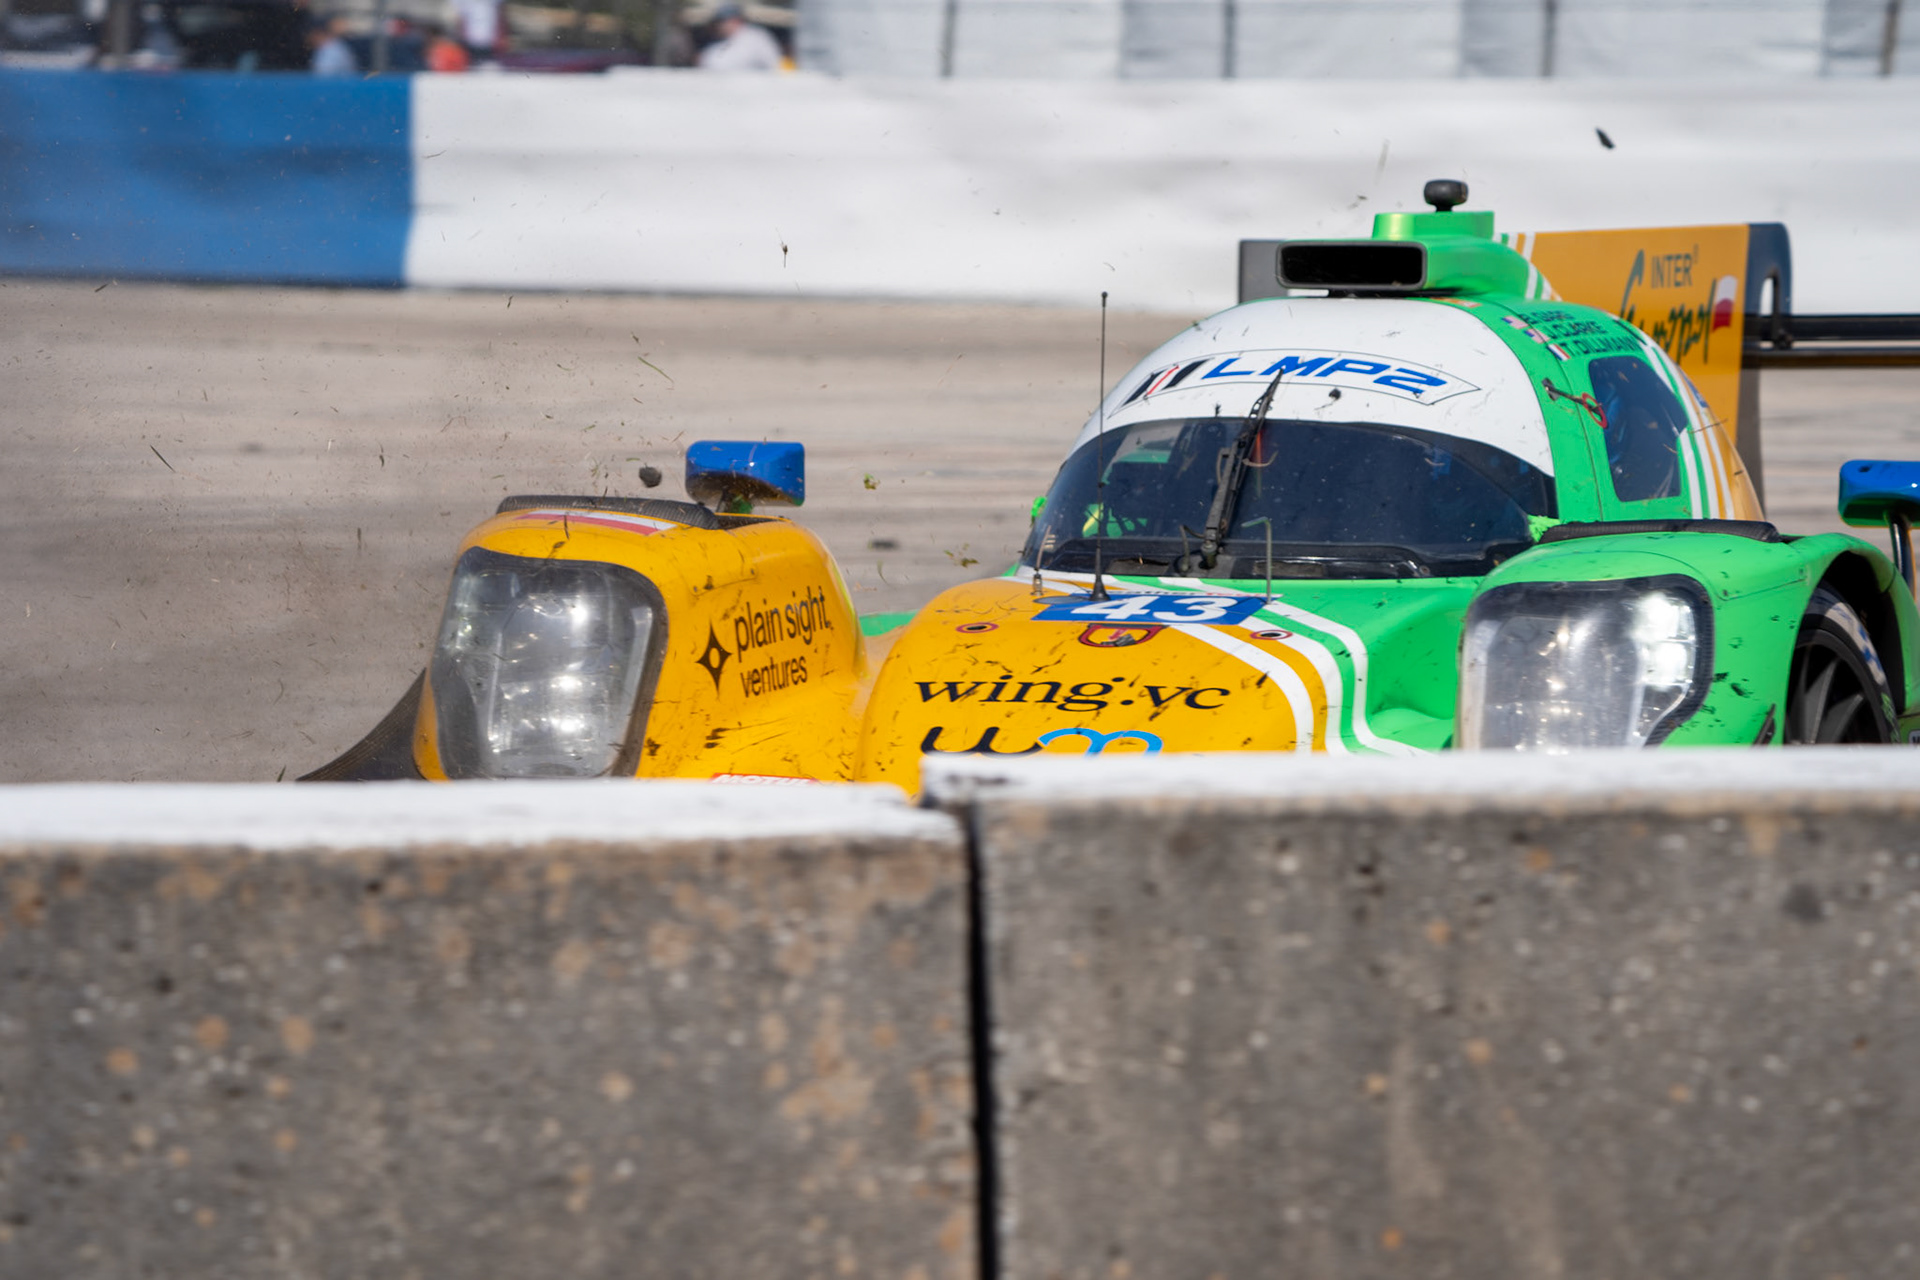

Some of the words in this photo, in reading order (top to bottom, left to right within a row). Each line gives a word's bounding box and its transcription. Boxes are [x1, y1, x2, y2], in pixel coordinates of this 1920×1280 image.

[1651, 253, 1693, 289] INTER
[1201, 356, 1447, 393] LMP2
[1069, 595, 1238, 621] 43
[734, 599, 783, 663] plain
[740, 655, 808, 698] ventures
